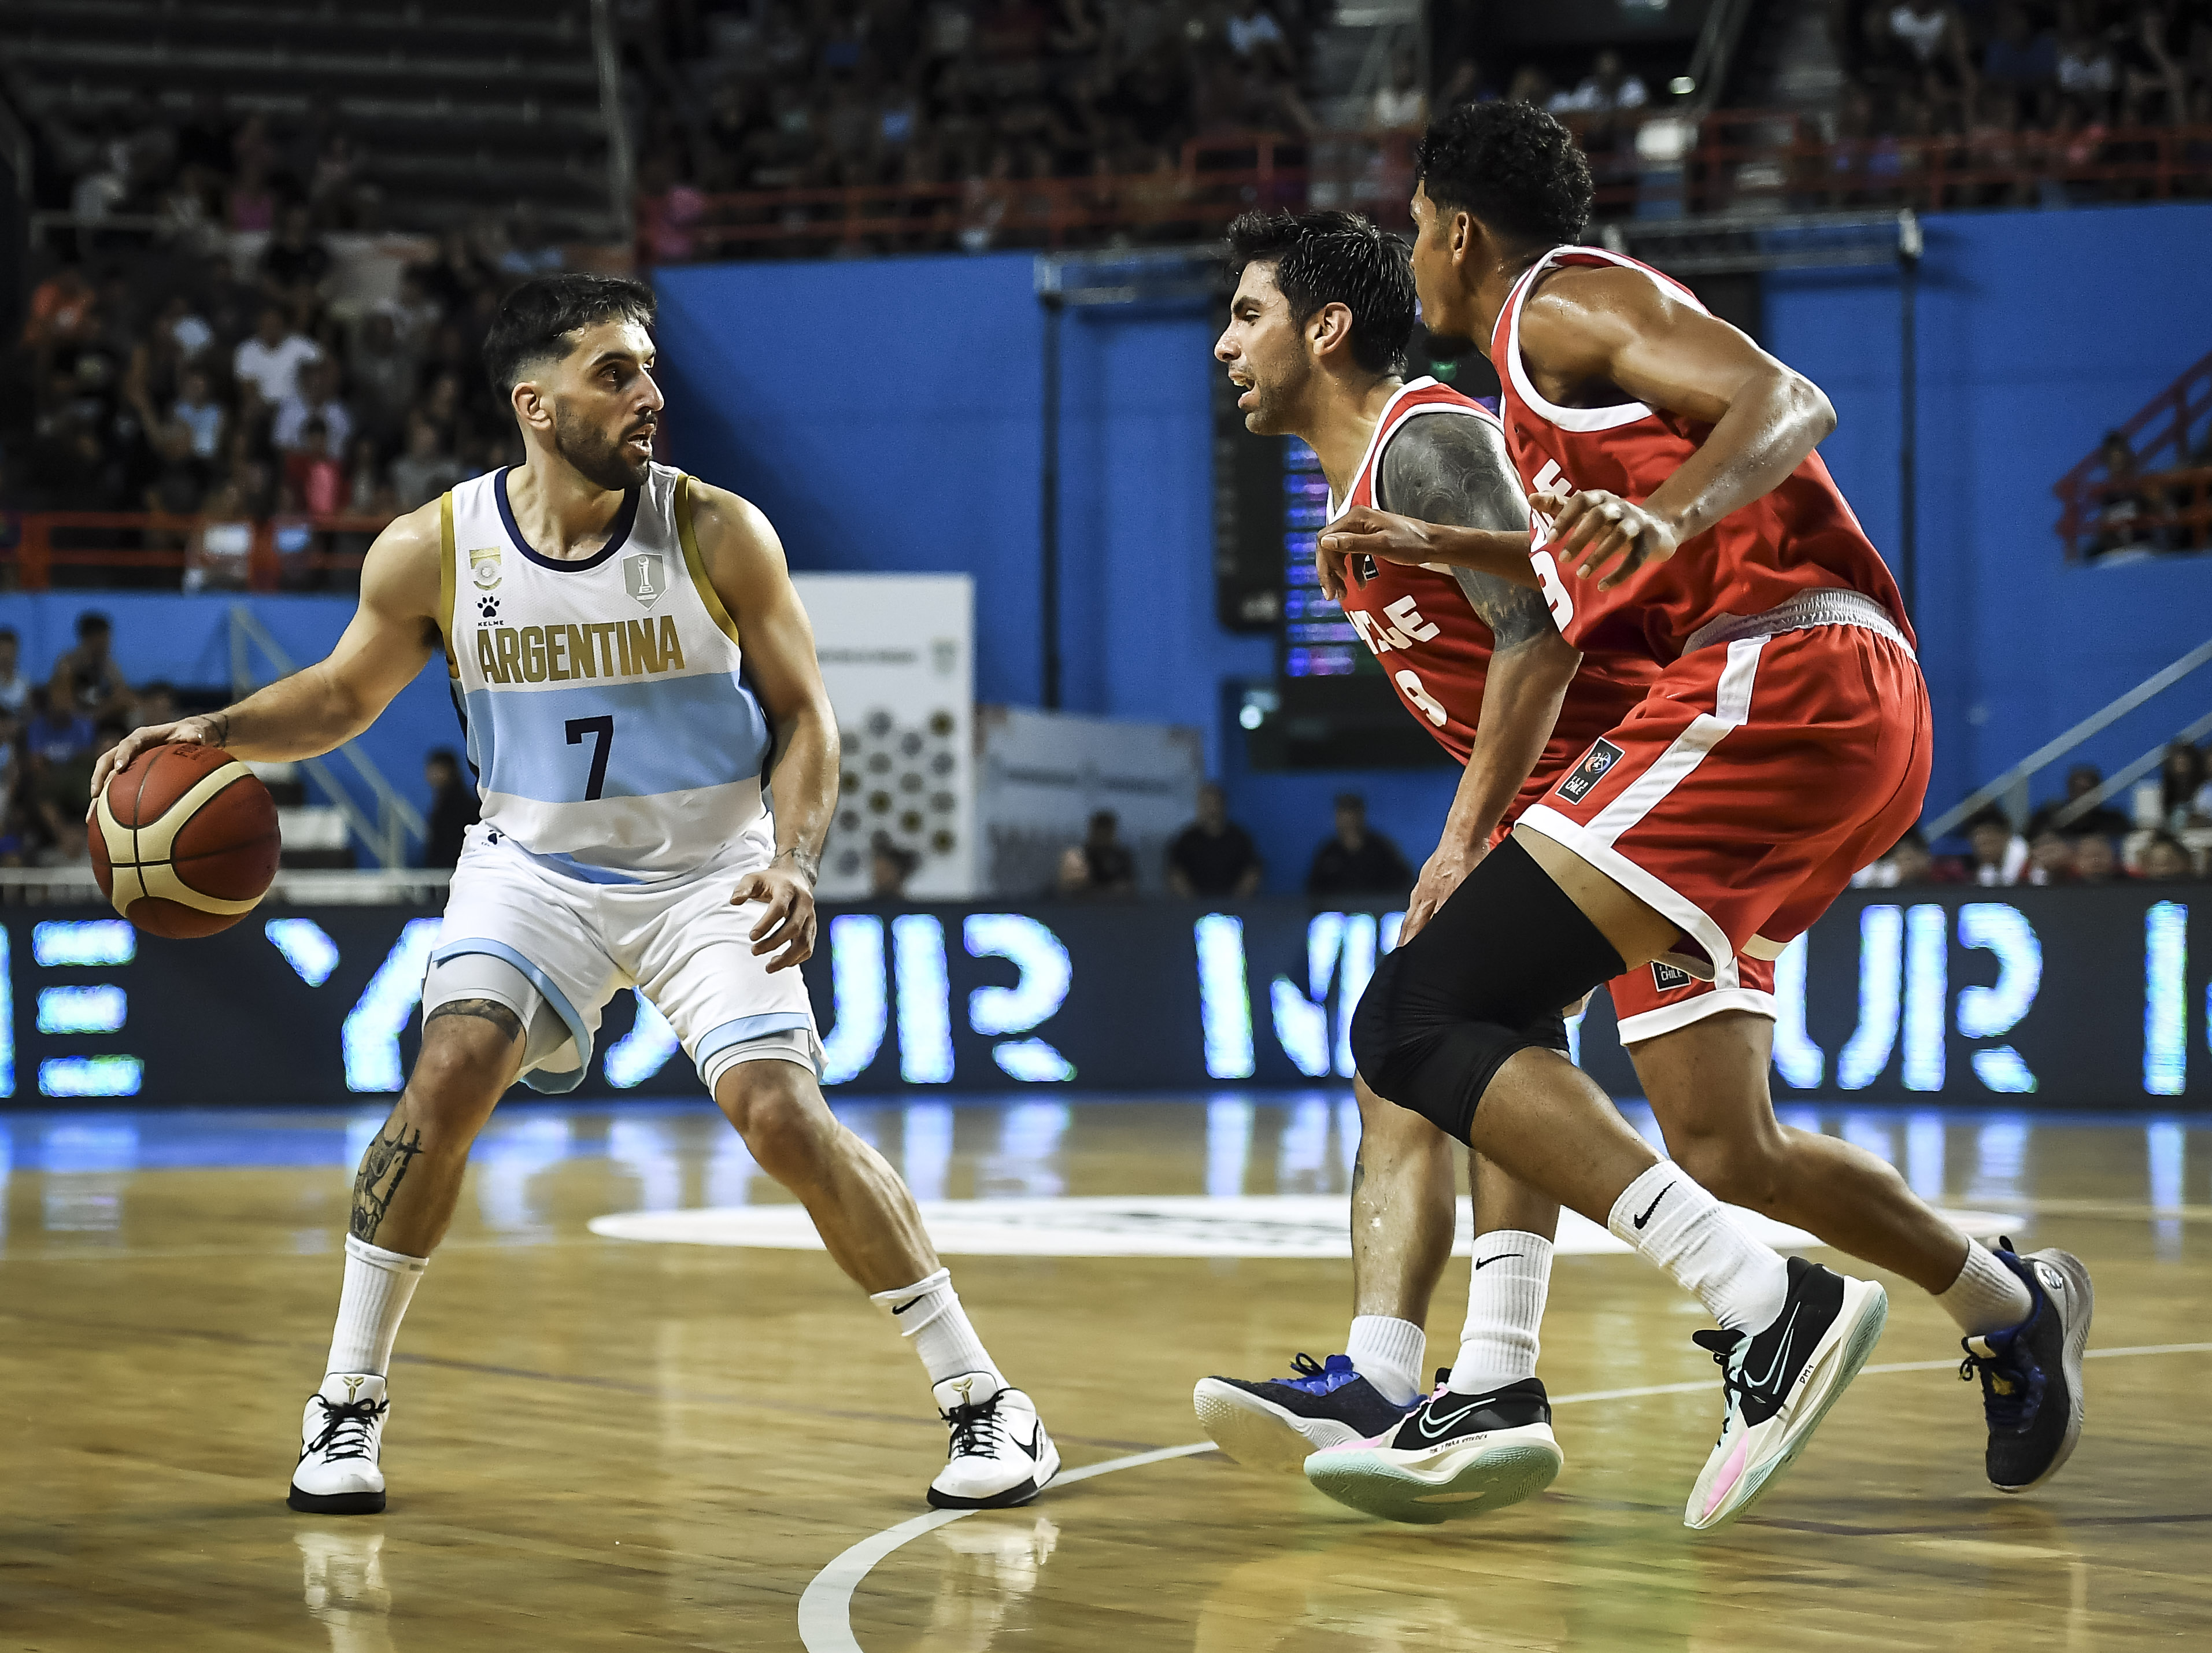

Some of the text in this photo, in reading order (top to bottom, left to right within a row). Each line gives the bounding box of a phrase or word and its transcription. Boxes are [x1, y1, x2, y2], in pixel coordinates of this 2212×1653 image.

[477, 615, 685, 683] ARGENTINA
[564, 715, 614, 801] 7
[1564, 781, 1585, 796] CHILE
[1660, 969, 1683, 981] CHILE
